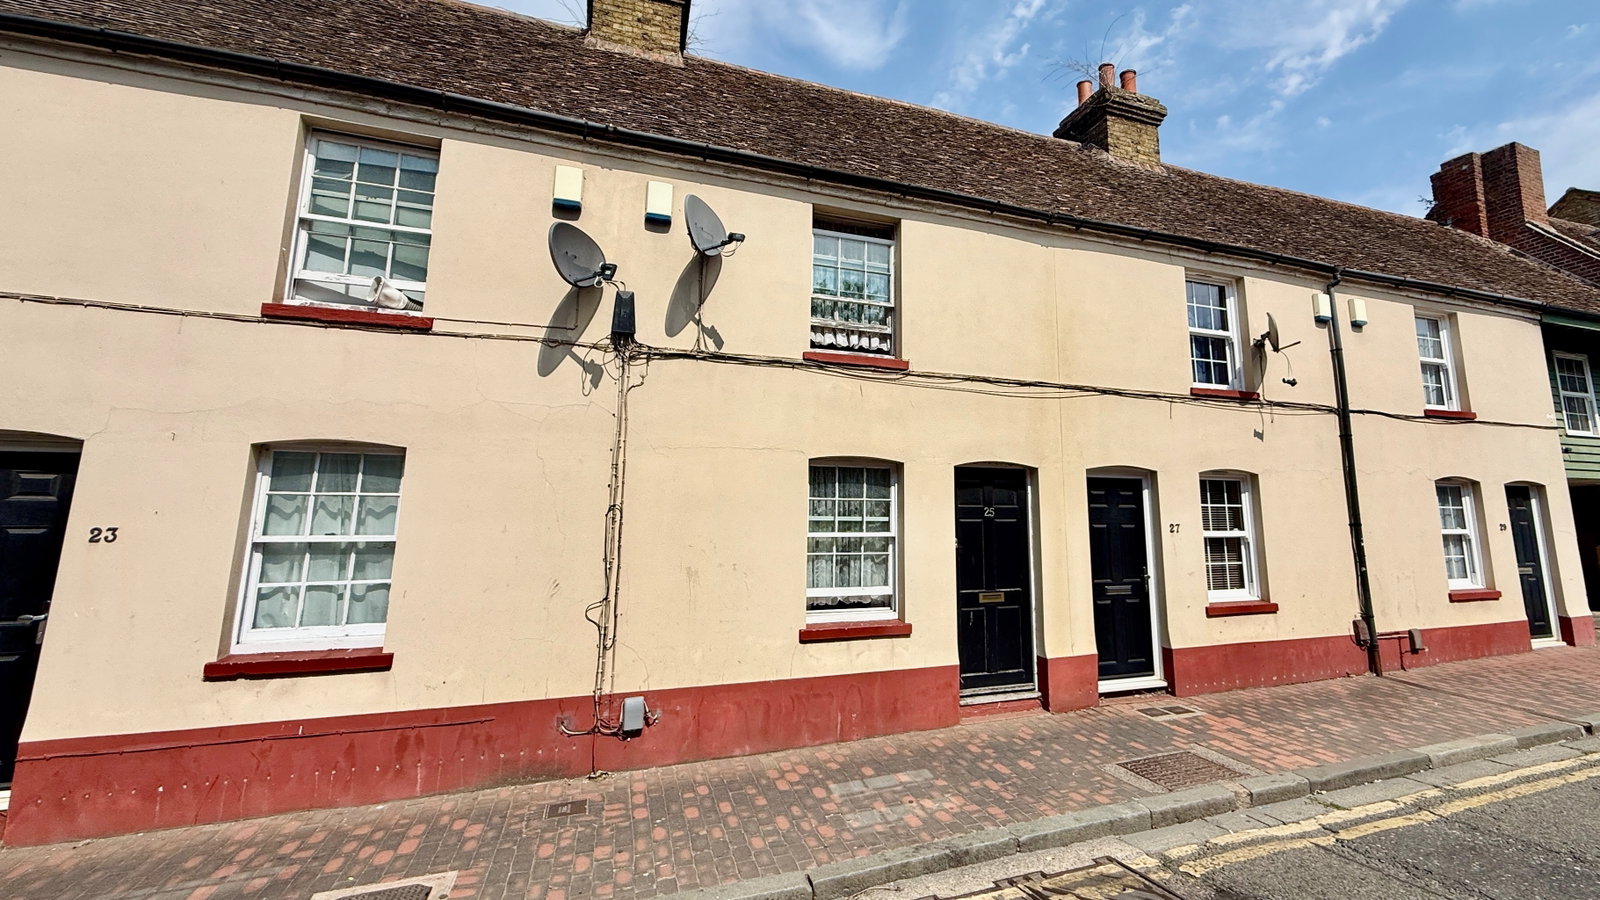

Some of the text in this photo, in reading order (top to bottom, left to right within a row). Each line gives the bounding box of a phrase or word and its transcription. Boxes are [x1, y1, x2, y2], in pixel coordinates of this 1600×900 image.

[984, 506, 995, 517] 25
[1169, 523, 1180, 533] 27
[88, 527, 119, 543] 23
